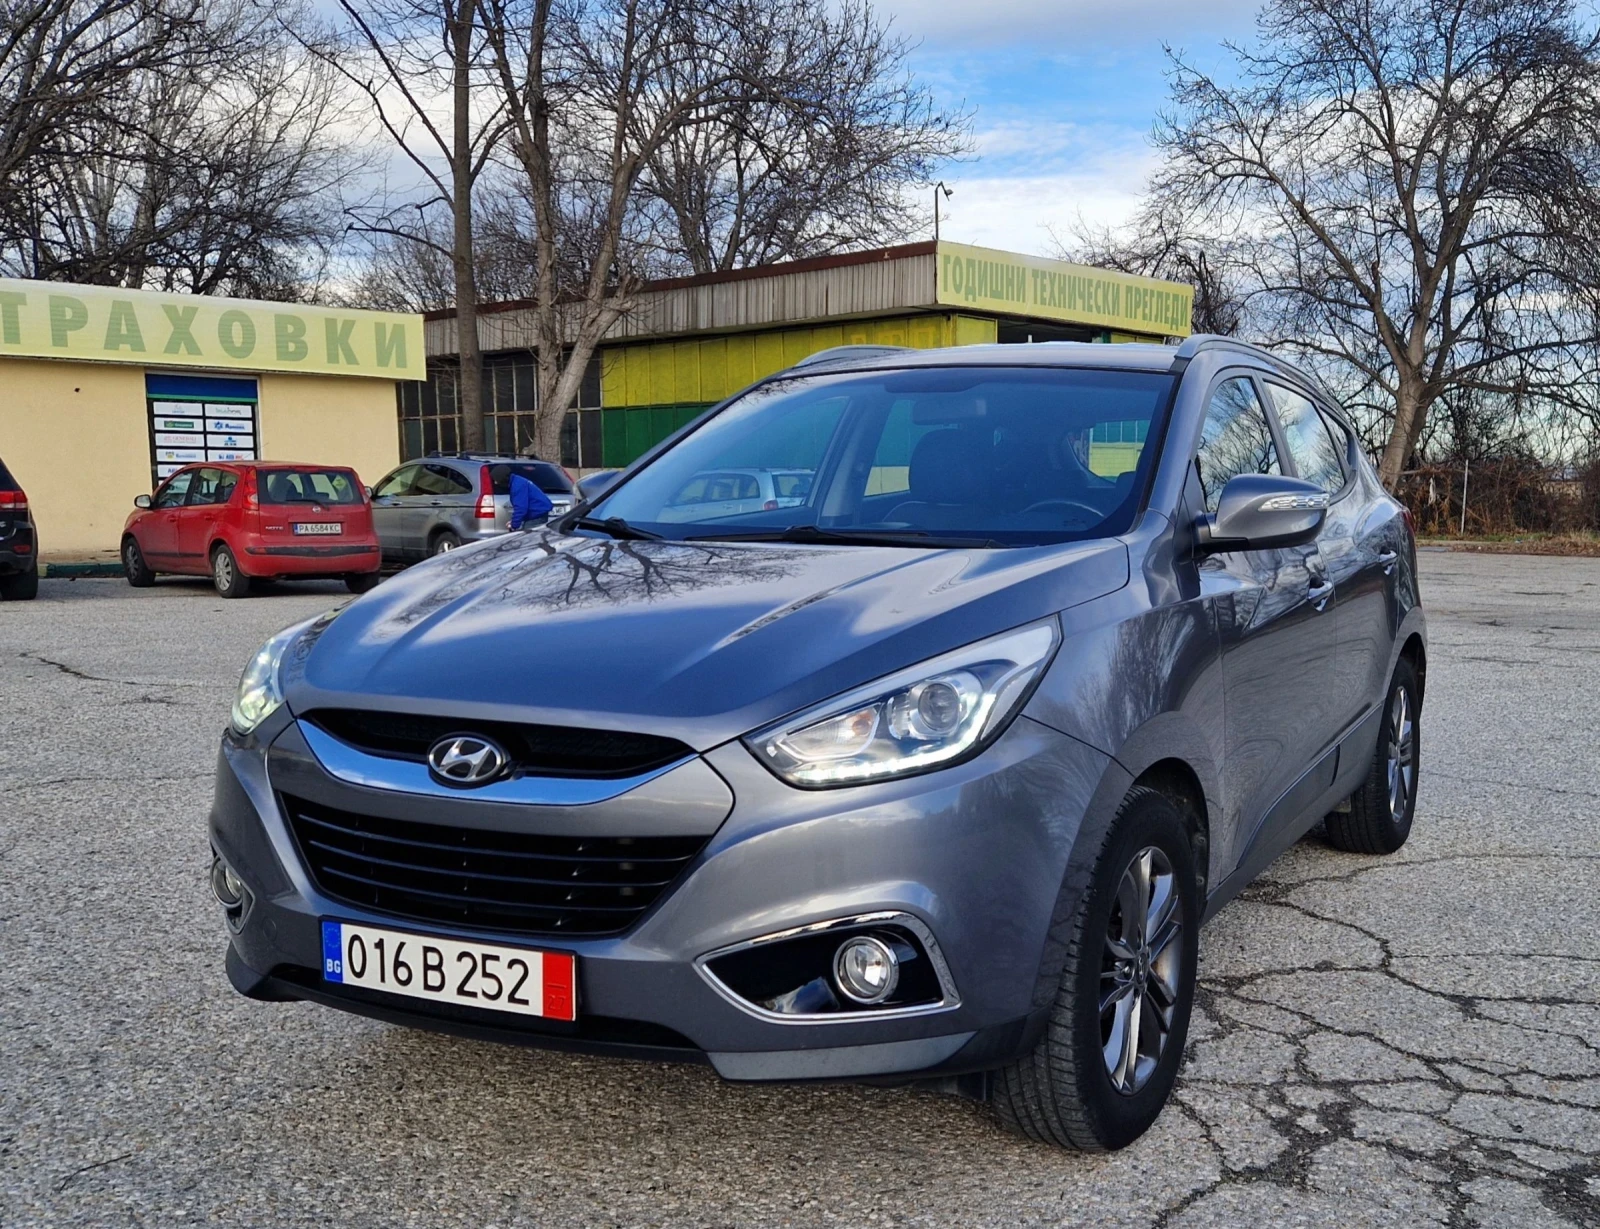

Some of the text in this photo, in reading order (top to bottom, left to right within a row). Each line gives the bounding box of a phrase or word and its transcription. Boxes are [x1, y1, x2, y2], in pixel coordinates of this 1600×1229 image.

[943, 254, 1188, 331] ГОДИШНИ ТЕХНИЧЕСКИ ПРЕГЛЕДИ
[326, 958, 341, 974] BG
